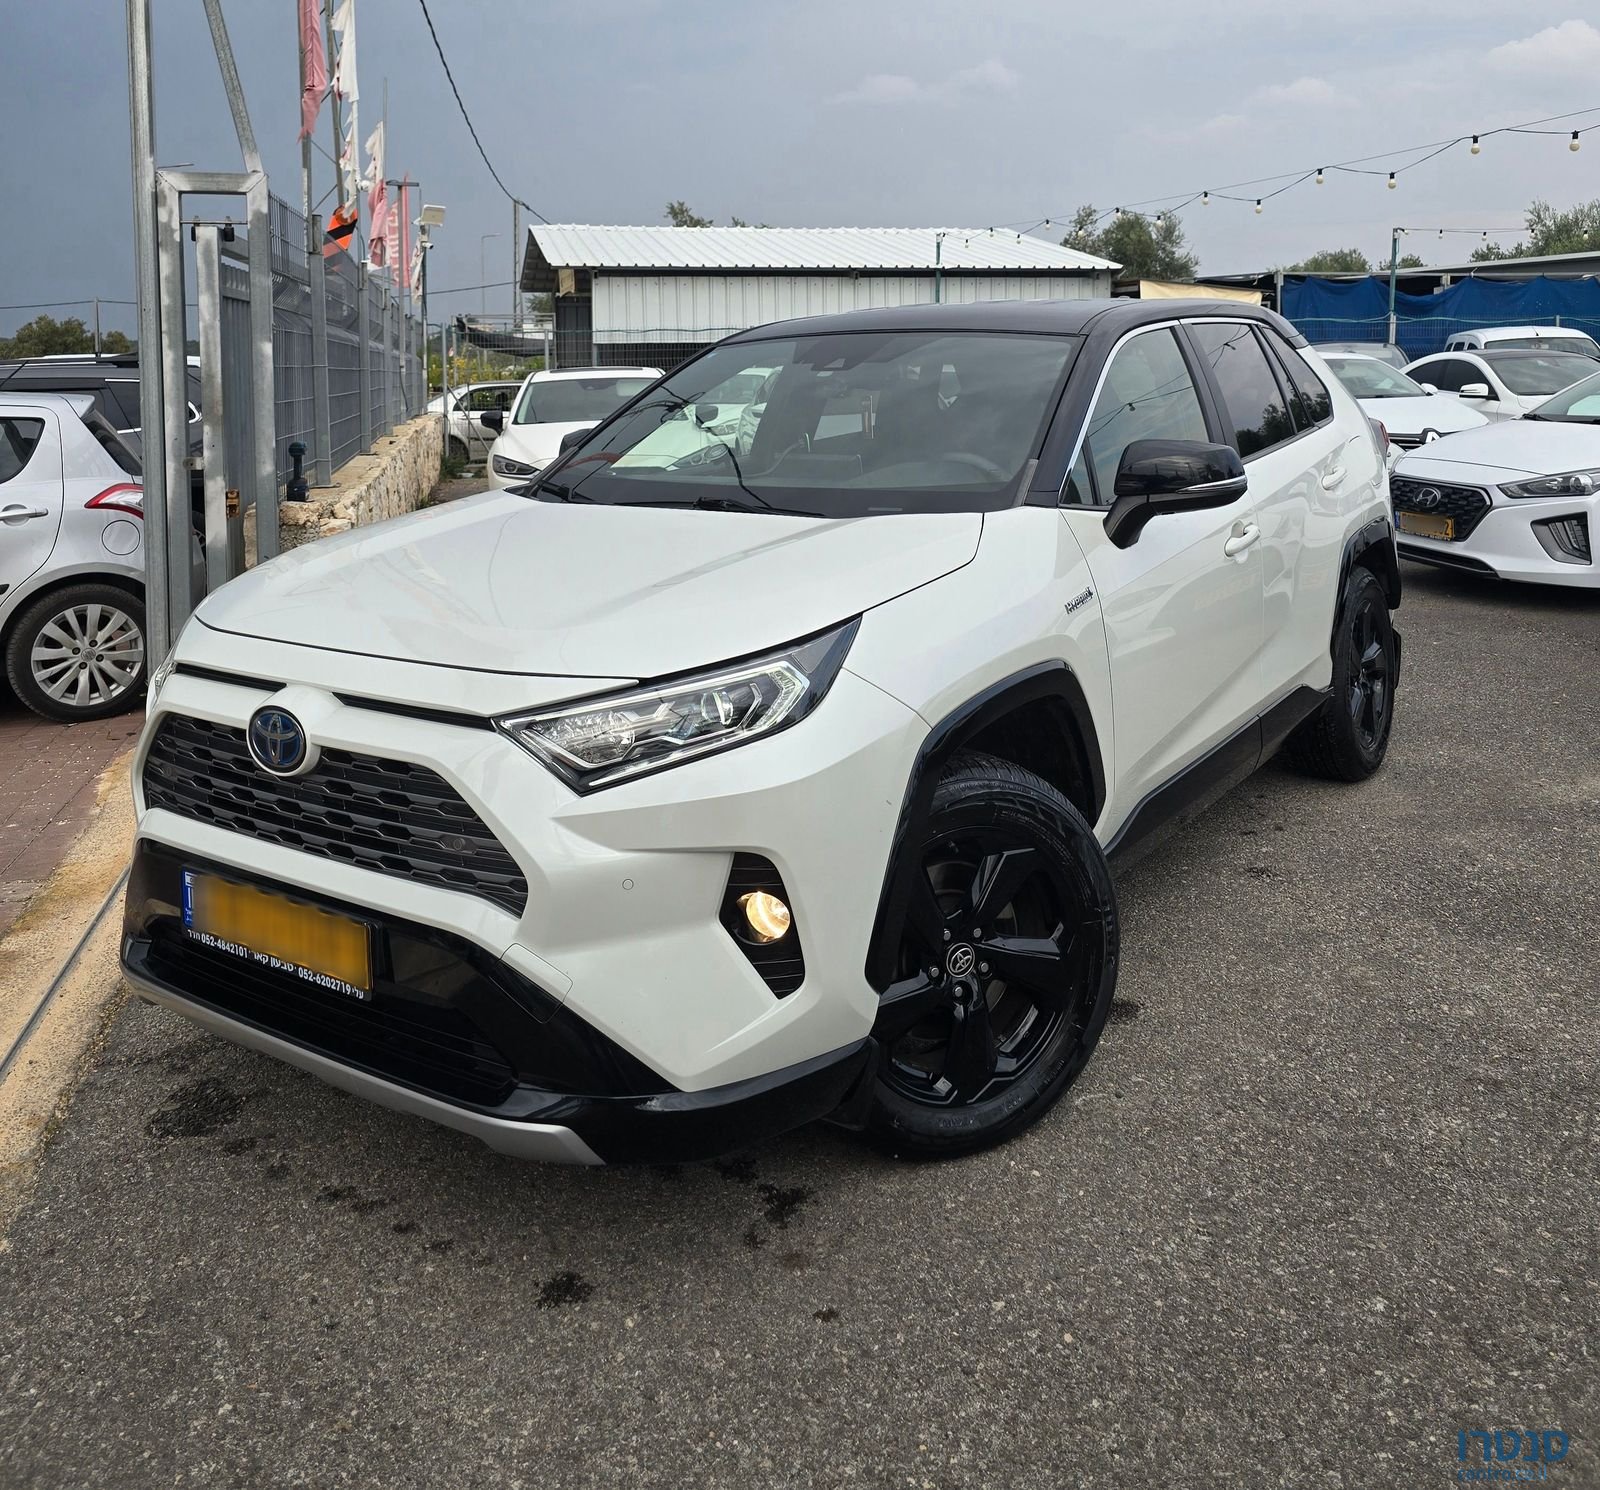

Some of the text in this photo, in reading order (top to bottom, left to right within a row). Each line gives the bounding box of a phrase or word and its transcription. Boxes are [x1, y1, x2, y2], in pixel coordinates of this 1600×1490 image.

[201, 933, 248, 958] 052-4842101
[270, 956, 294, 972] טבעון
[298, 967, 351, 995] 052-6202719
